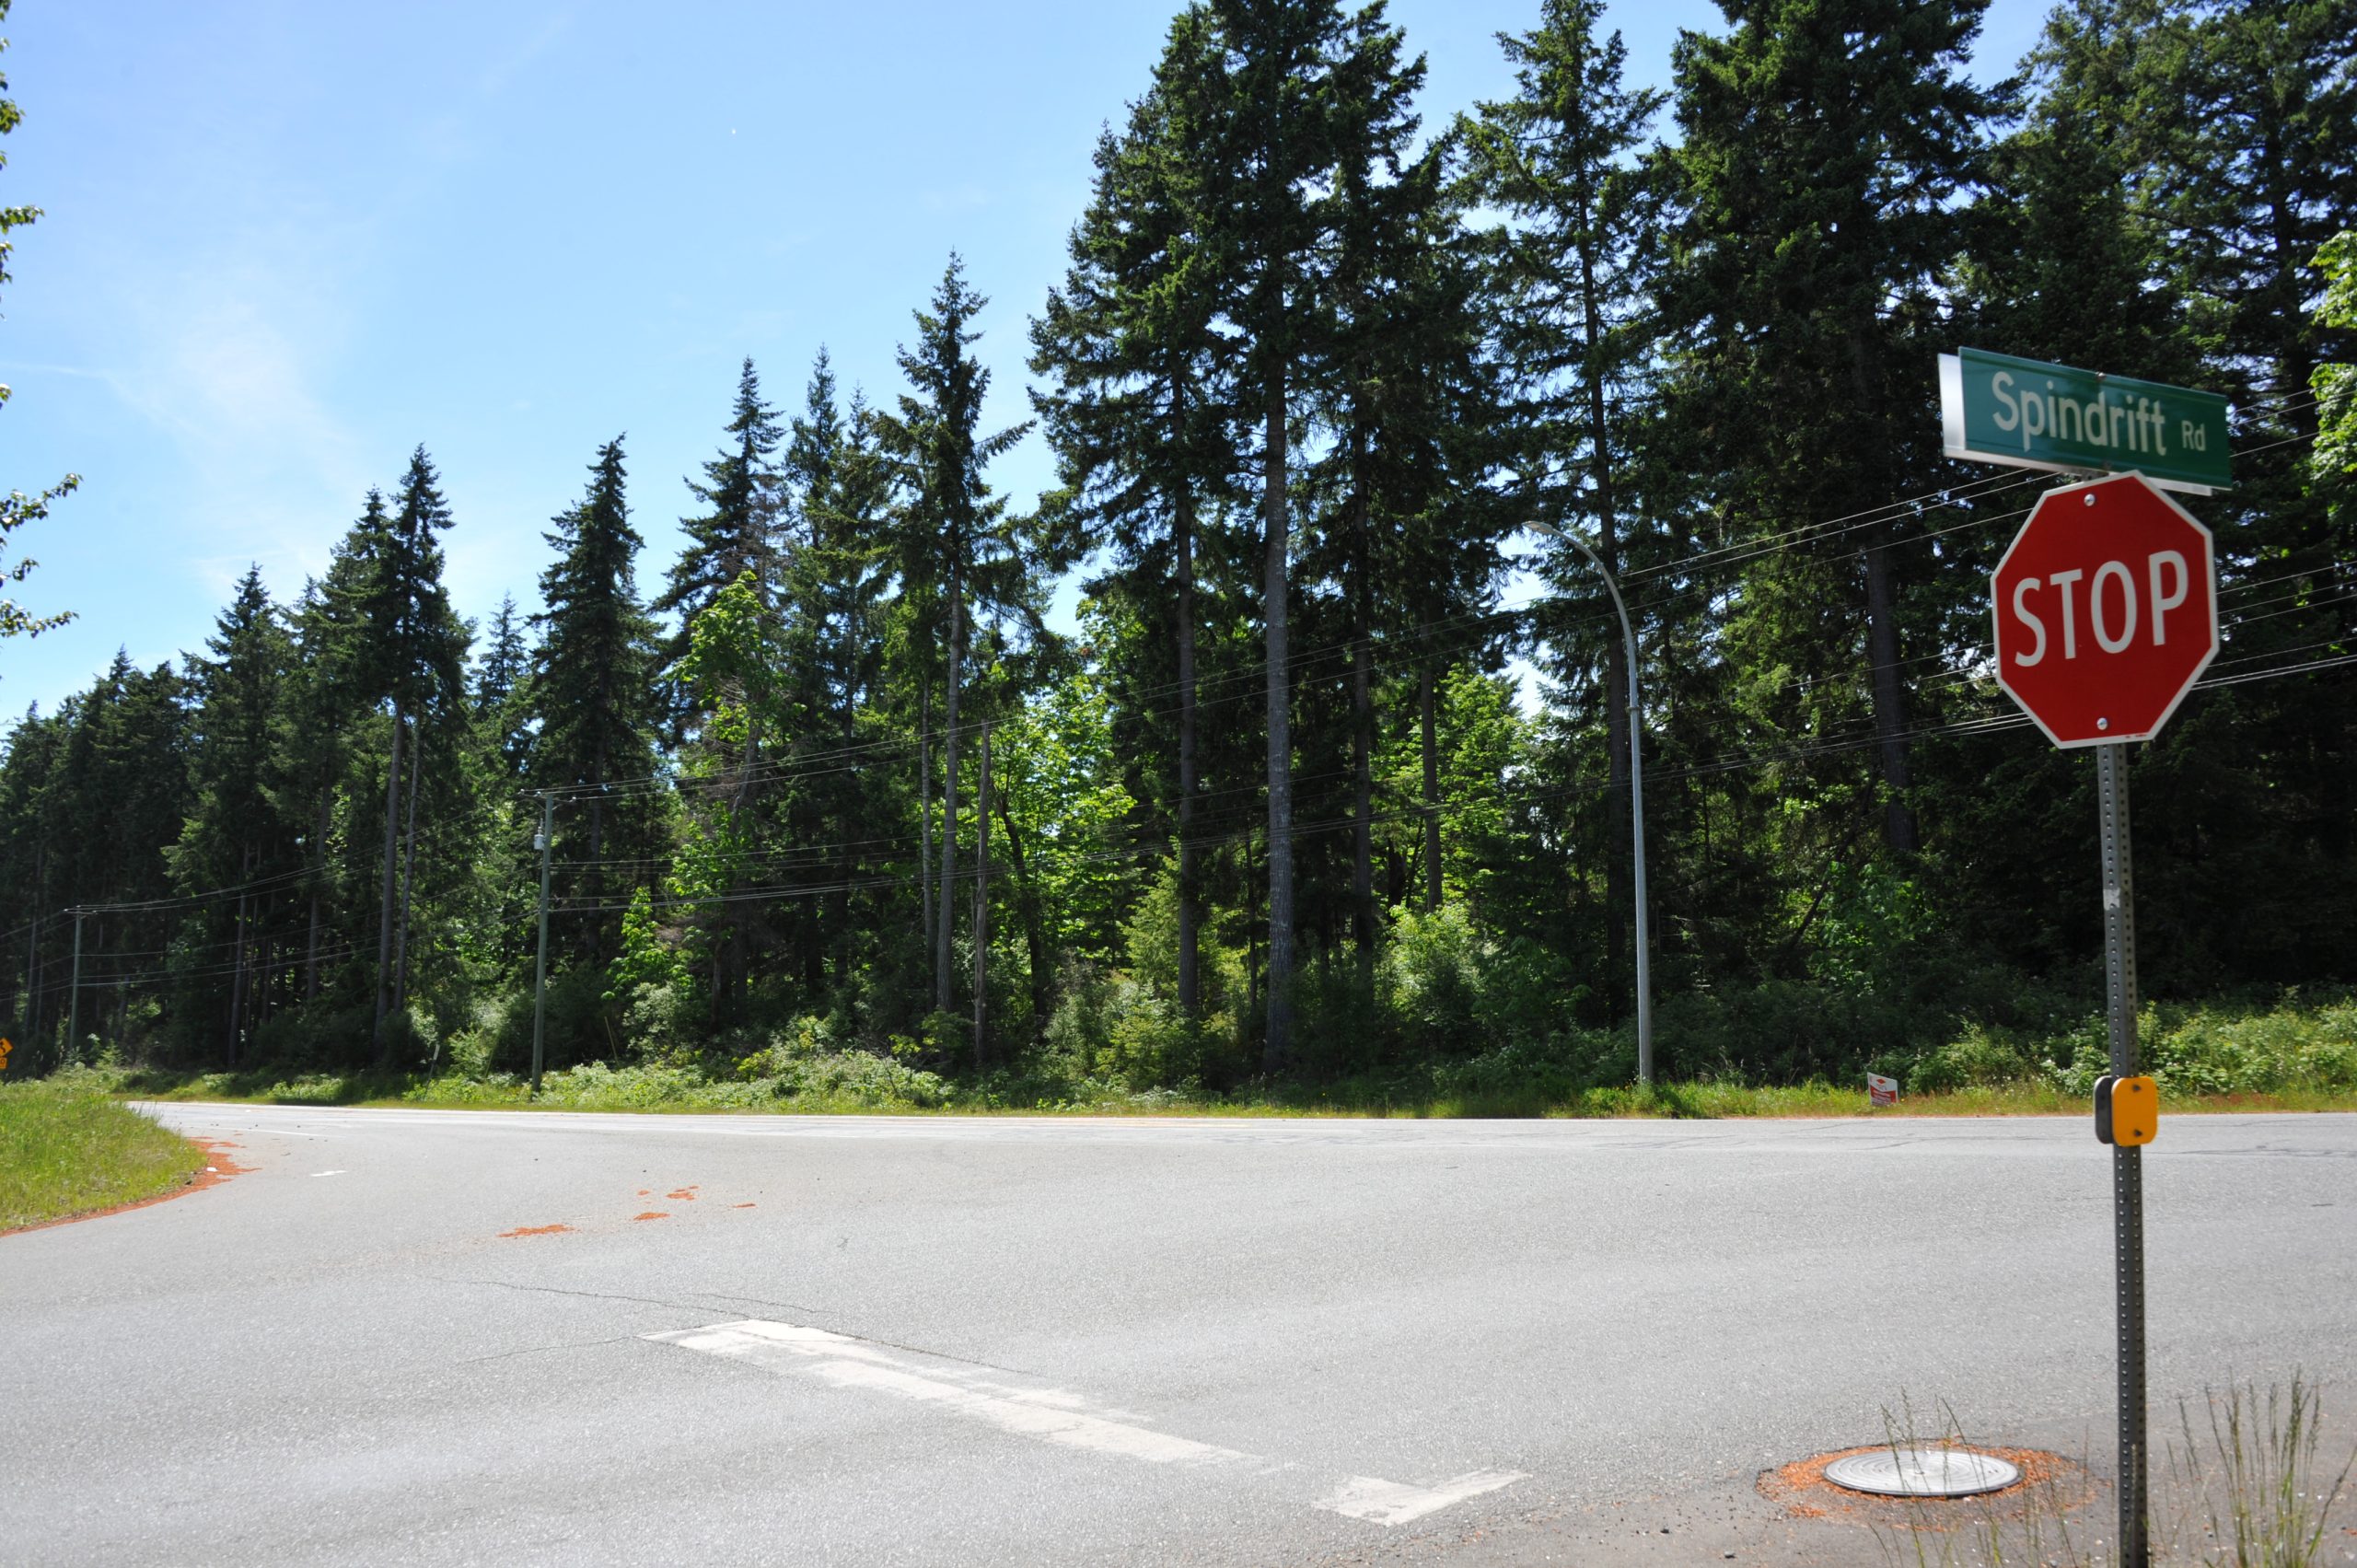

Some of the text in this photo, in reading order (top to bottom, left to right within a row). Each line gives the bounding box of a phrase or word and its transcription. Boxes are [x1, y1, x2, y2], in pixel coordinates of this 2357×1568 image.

[1991, 372, 2205, 456] Spindrift Rd
[2013, 550, 2189, 667] STOP
